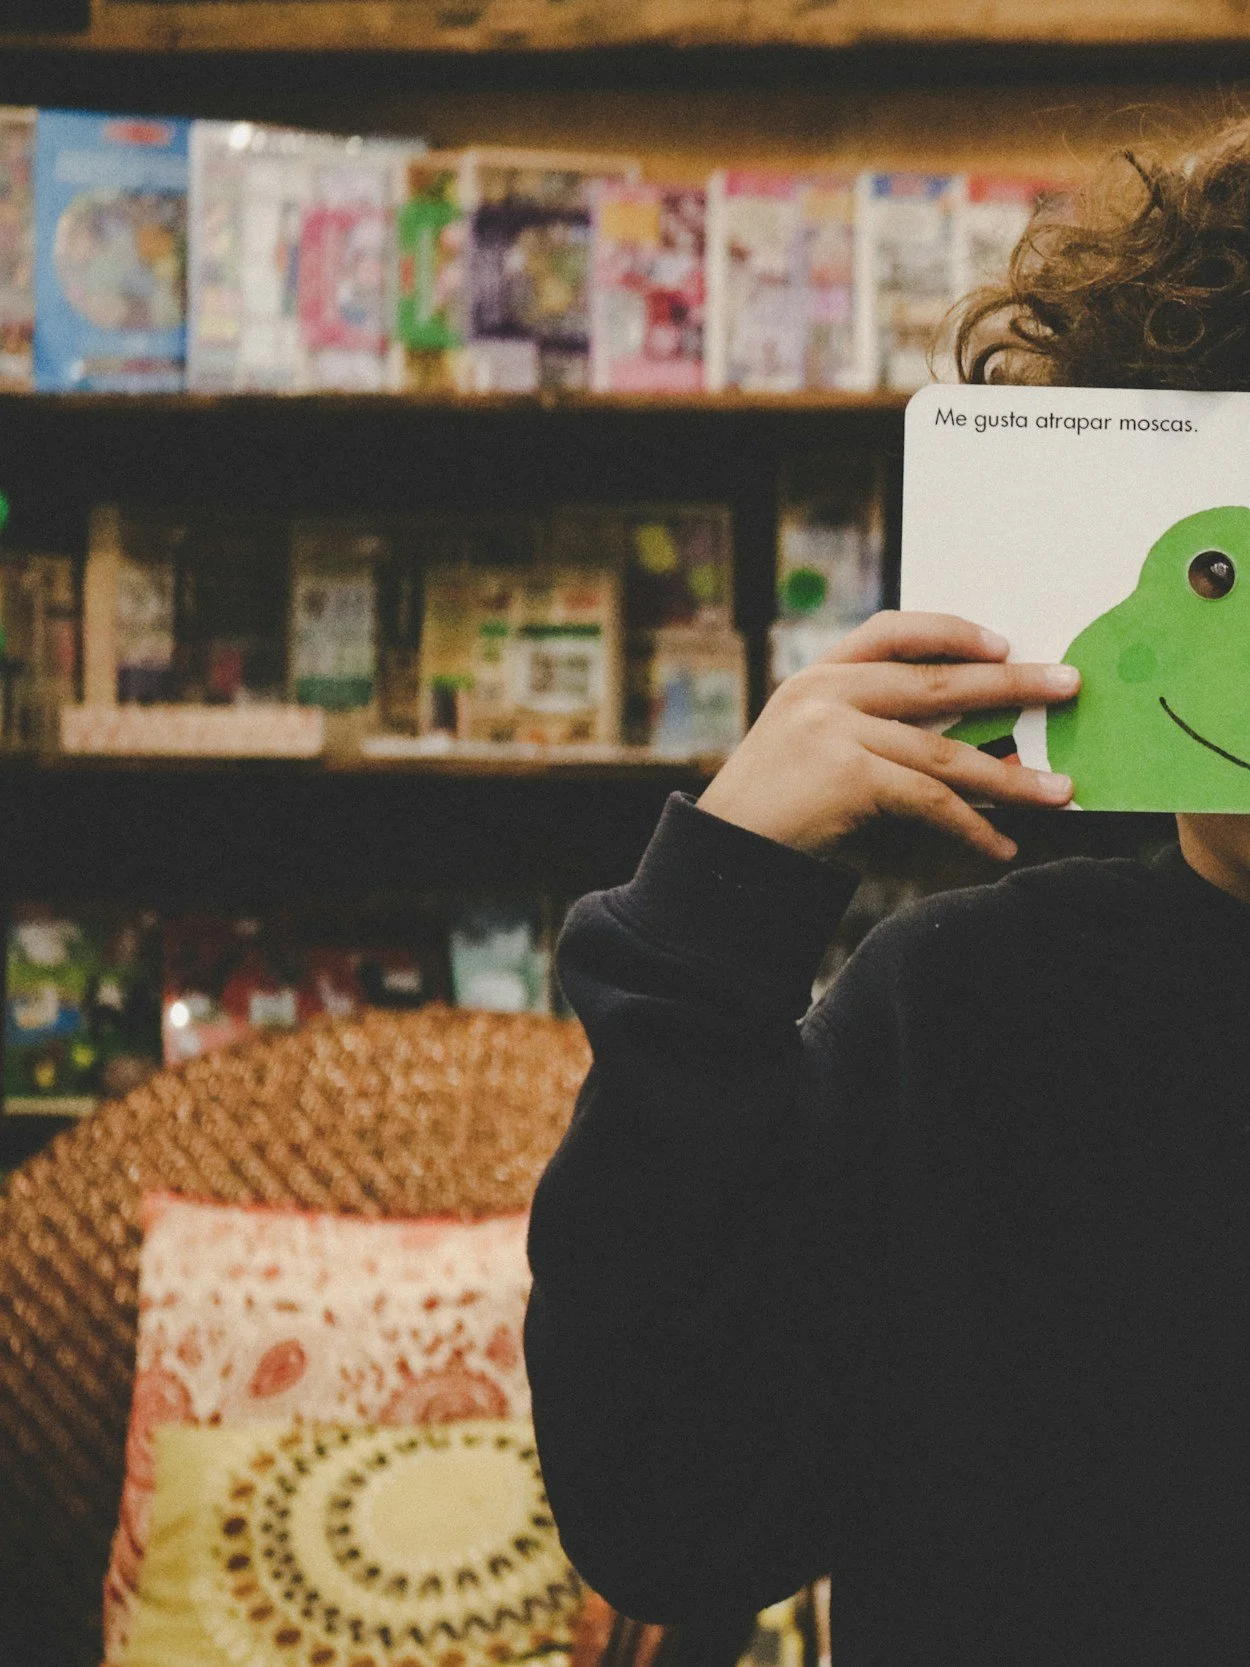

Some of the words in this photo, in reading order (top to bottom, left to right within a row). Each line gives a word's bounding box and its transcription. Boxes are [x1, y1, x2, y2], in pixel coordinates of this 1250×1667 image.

[935, 408, 967, 427] Me
[974, 411, 1028, 433] gusta
[1035, 412, 1112, 435] atrapar
[1119, 416, 1199, 433] moscas.
